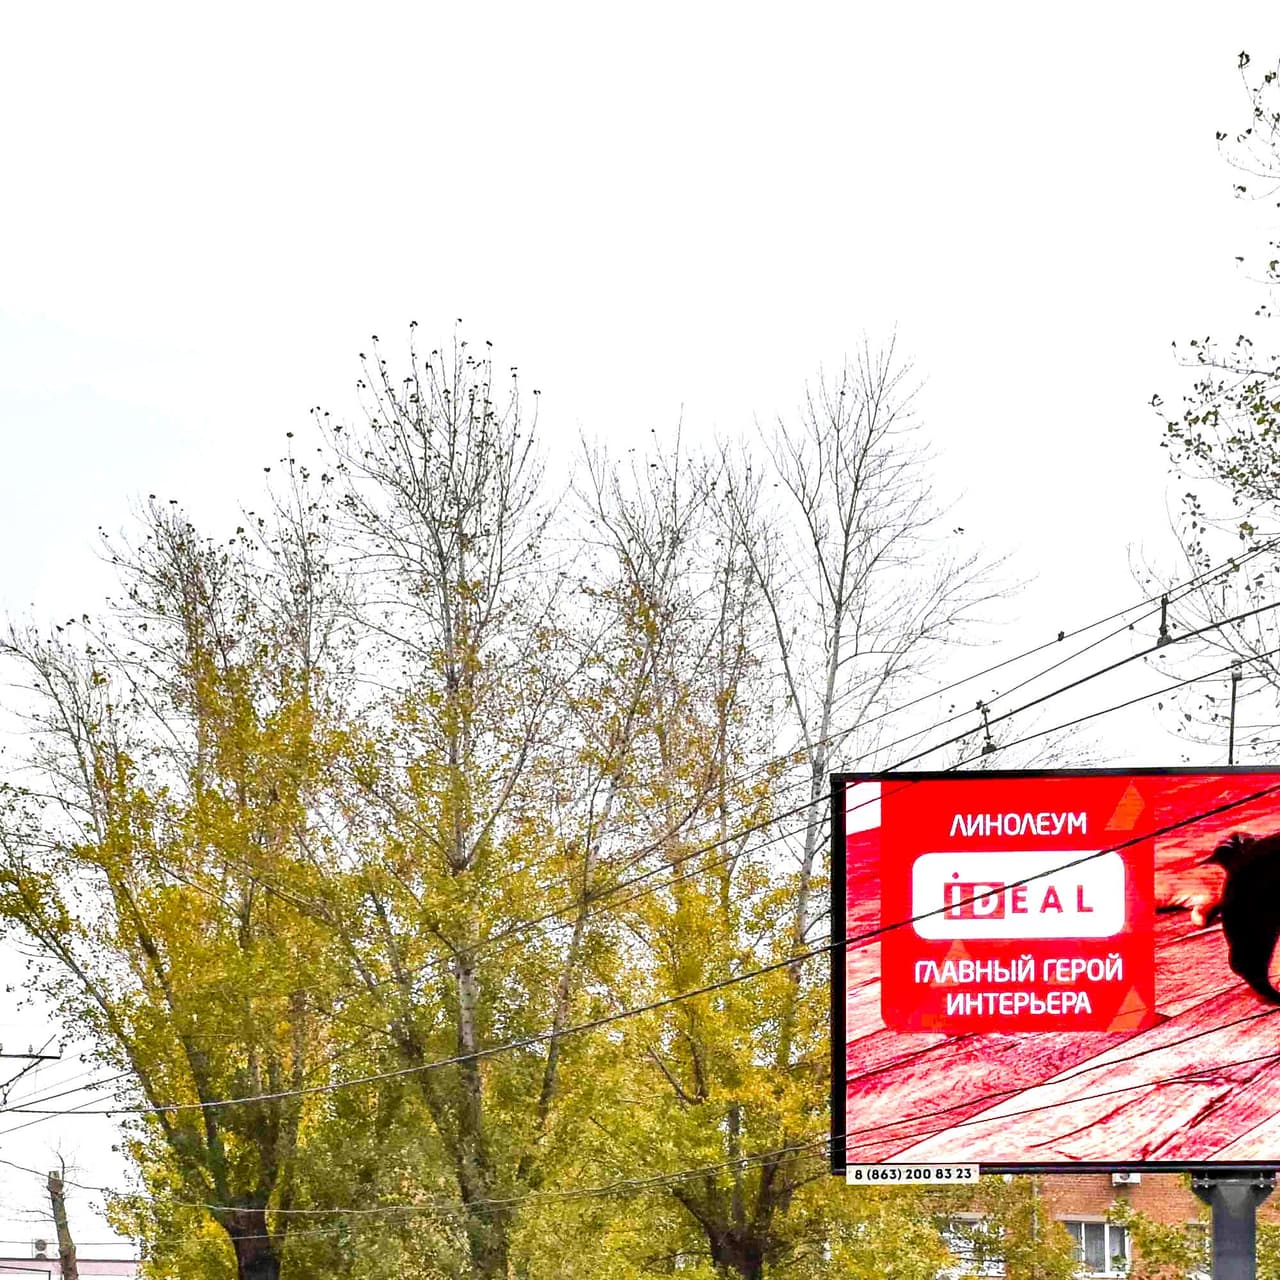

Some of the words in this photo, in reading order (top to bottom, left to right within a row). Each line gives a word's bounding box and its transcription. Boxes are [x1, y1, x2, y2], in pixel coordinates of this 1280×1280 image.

[949, 811, 1087, 837] ЛИНОЛЕУМ
[915, 953, 1035, 984] ГЛАВНЫЙ
[1043, 952, 1123, 982] ГЕРОЙ
[946, 991, 1092, 1016] ИНТЕРЬЕРА
[854, 1169, 863, 1180] 8
[867, 1168, 902, 1180] (863)
[905, 1168, 931, 1179] 200
[935, 1168, 952, 1179] 83
[956, 1168, 972, 1179] 23
